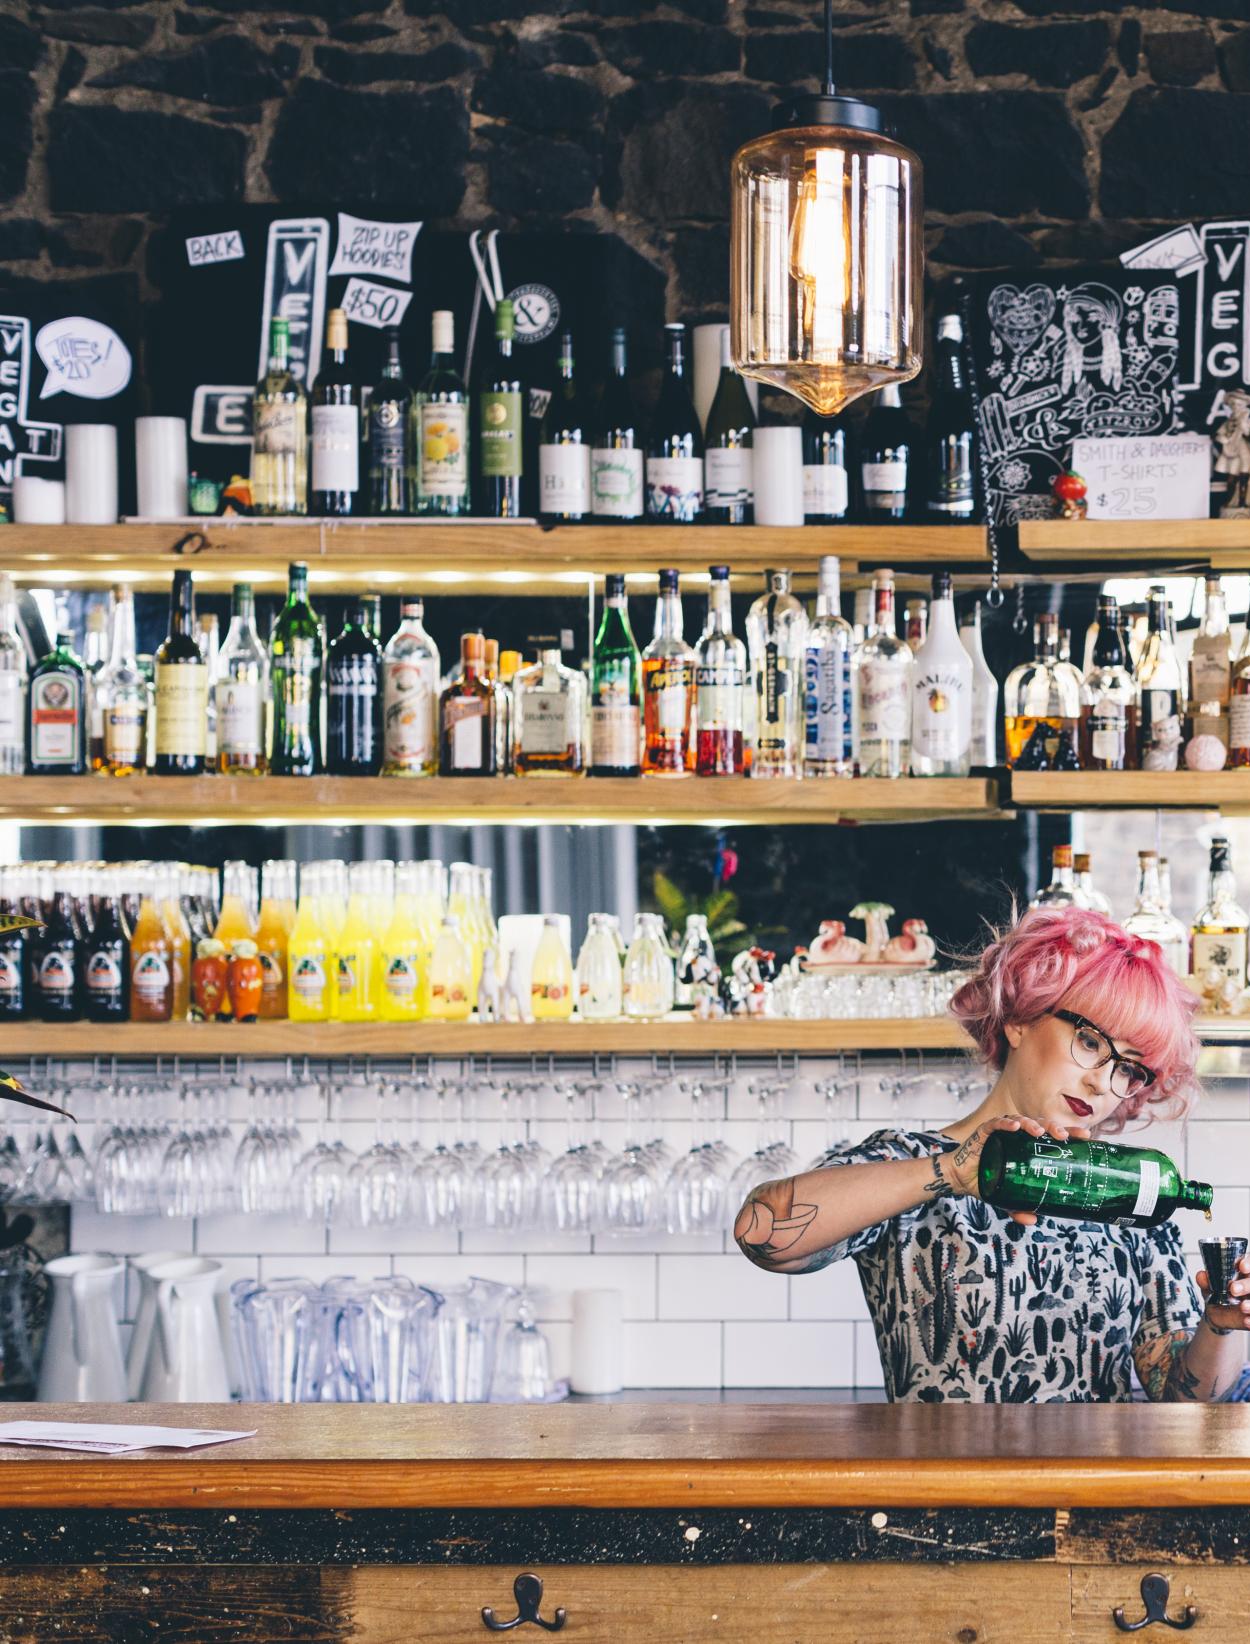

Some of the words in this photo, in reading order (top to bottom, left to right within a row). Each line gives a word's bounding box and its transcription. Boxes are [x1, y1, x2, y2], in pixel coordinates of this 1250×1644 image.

[190, 235, 239, 262] BACK
[353, 226, 380, 246] ZIP
[385, 230, 409, 248] UP
[347, 286, 399, 323] $50
[1078, 444, 1126, 463] SMITH
[1131, 443, 1145, 458] &
[1097, 463, 1178, 482] T-SHIRTS
[1096, 486, 1158, 516] $25
